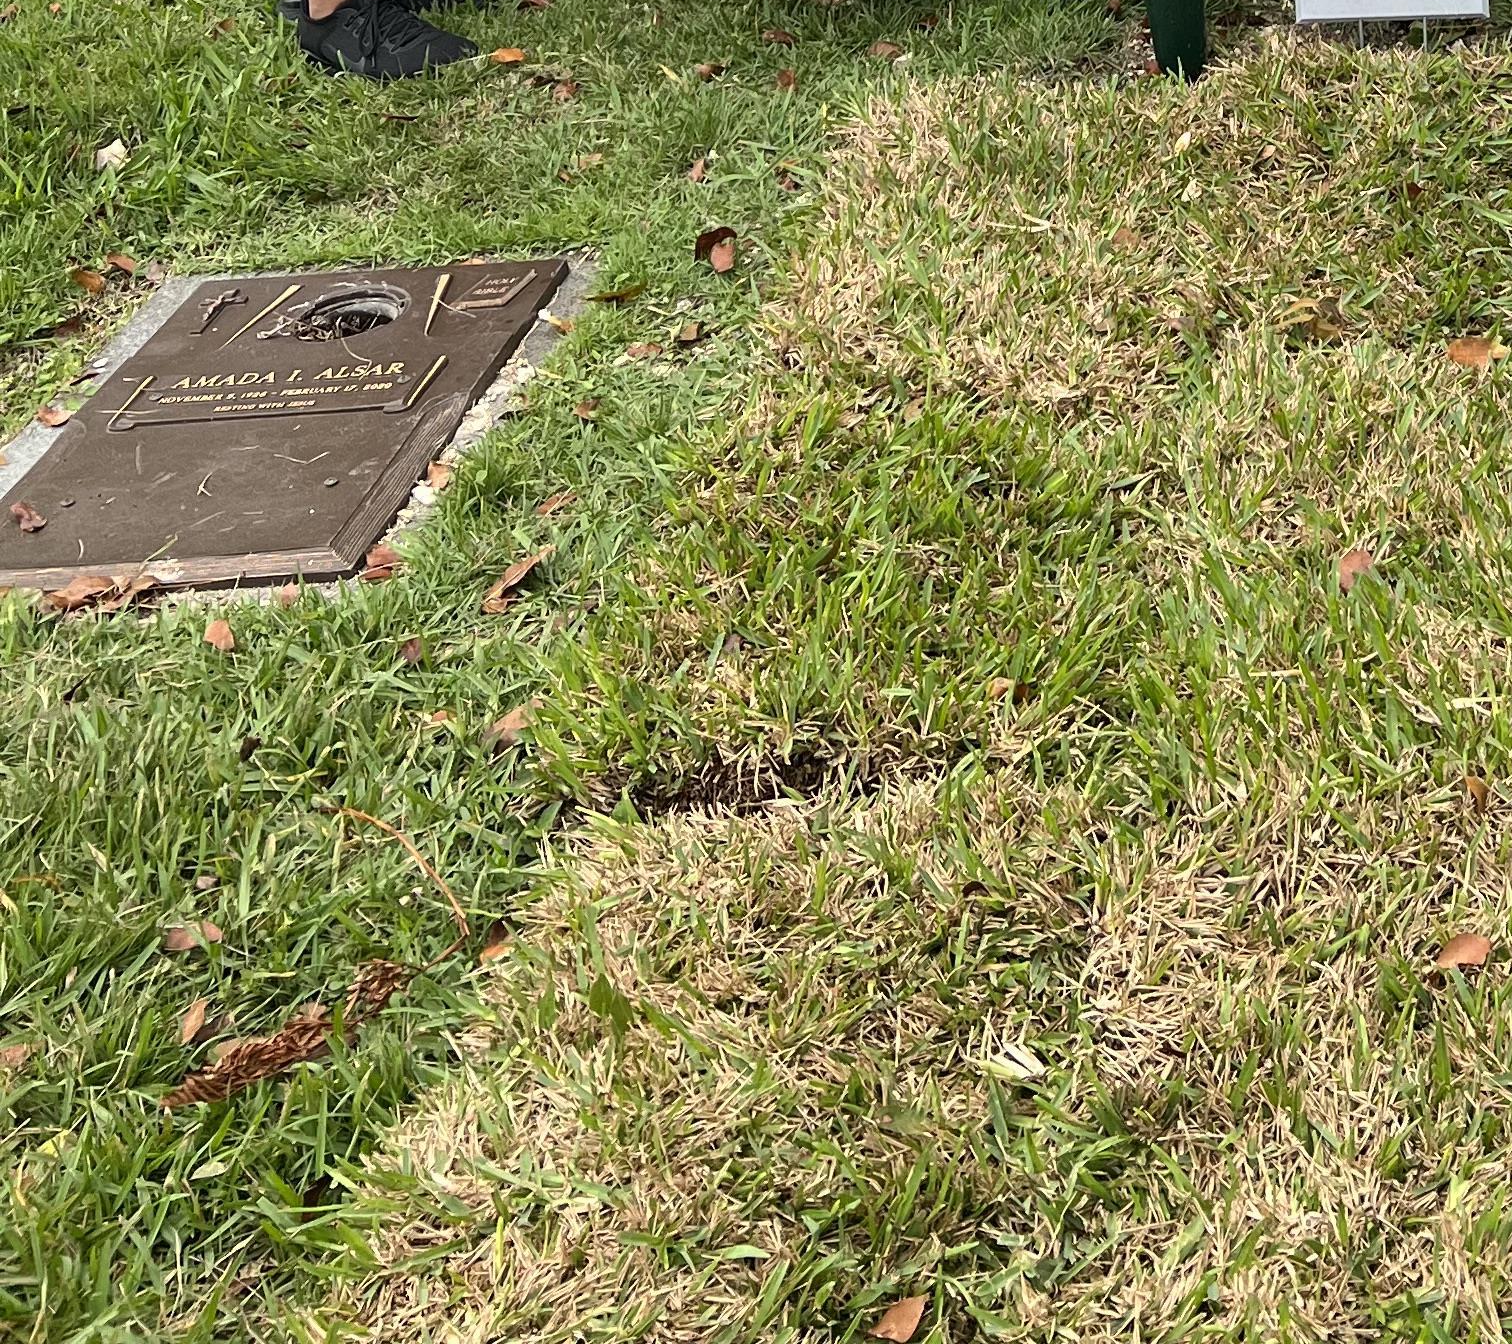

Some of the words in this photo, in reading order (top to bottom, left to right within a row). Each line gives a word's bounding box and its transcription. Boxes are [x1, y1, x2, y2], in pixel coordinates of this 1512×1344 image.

[170, 371, 276, 390] AMADA
[285, 369, 303, 383] I.
[314, 362, 406, 381] ALSAR
[157, 393, 224, 404] NOVEMBER
[279, 385, 342, 397] FEBRUARY
[213, 402, 255, 413] RESTING
[257, 400, 286, 409] WITH
